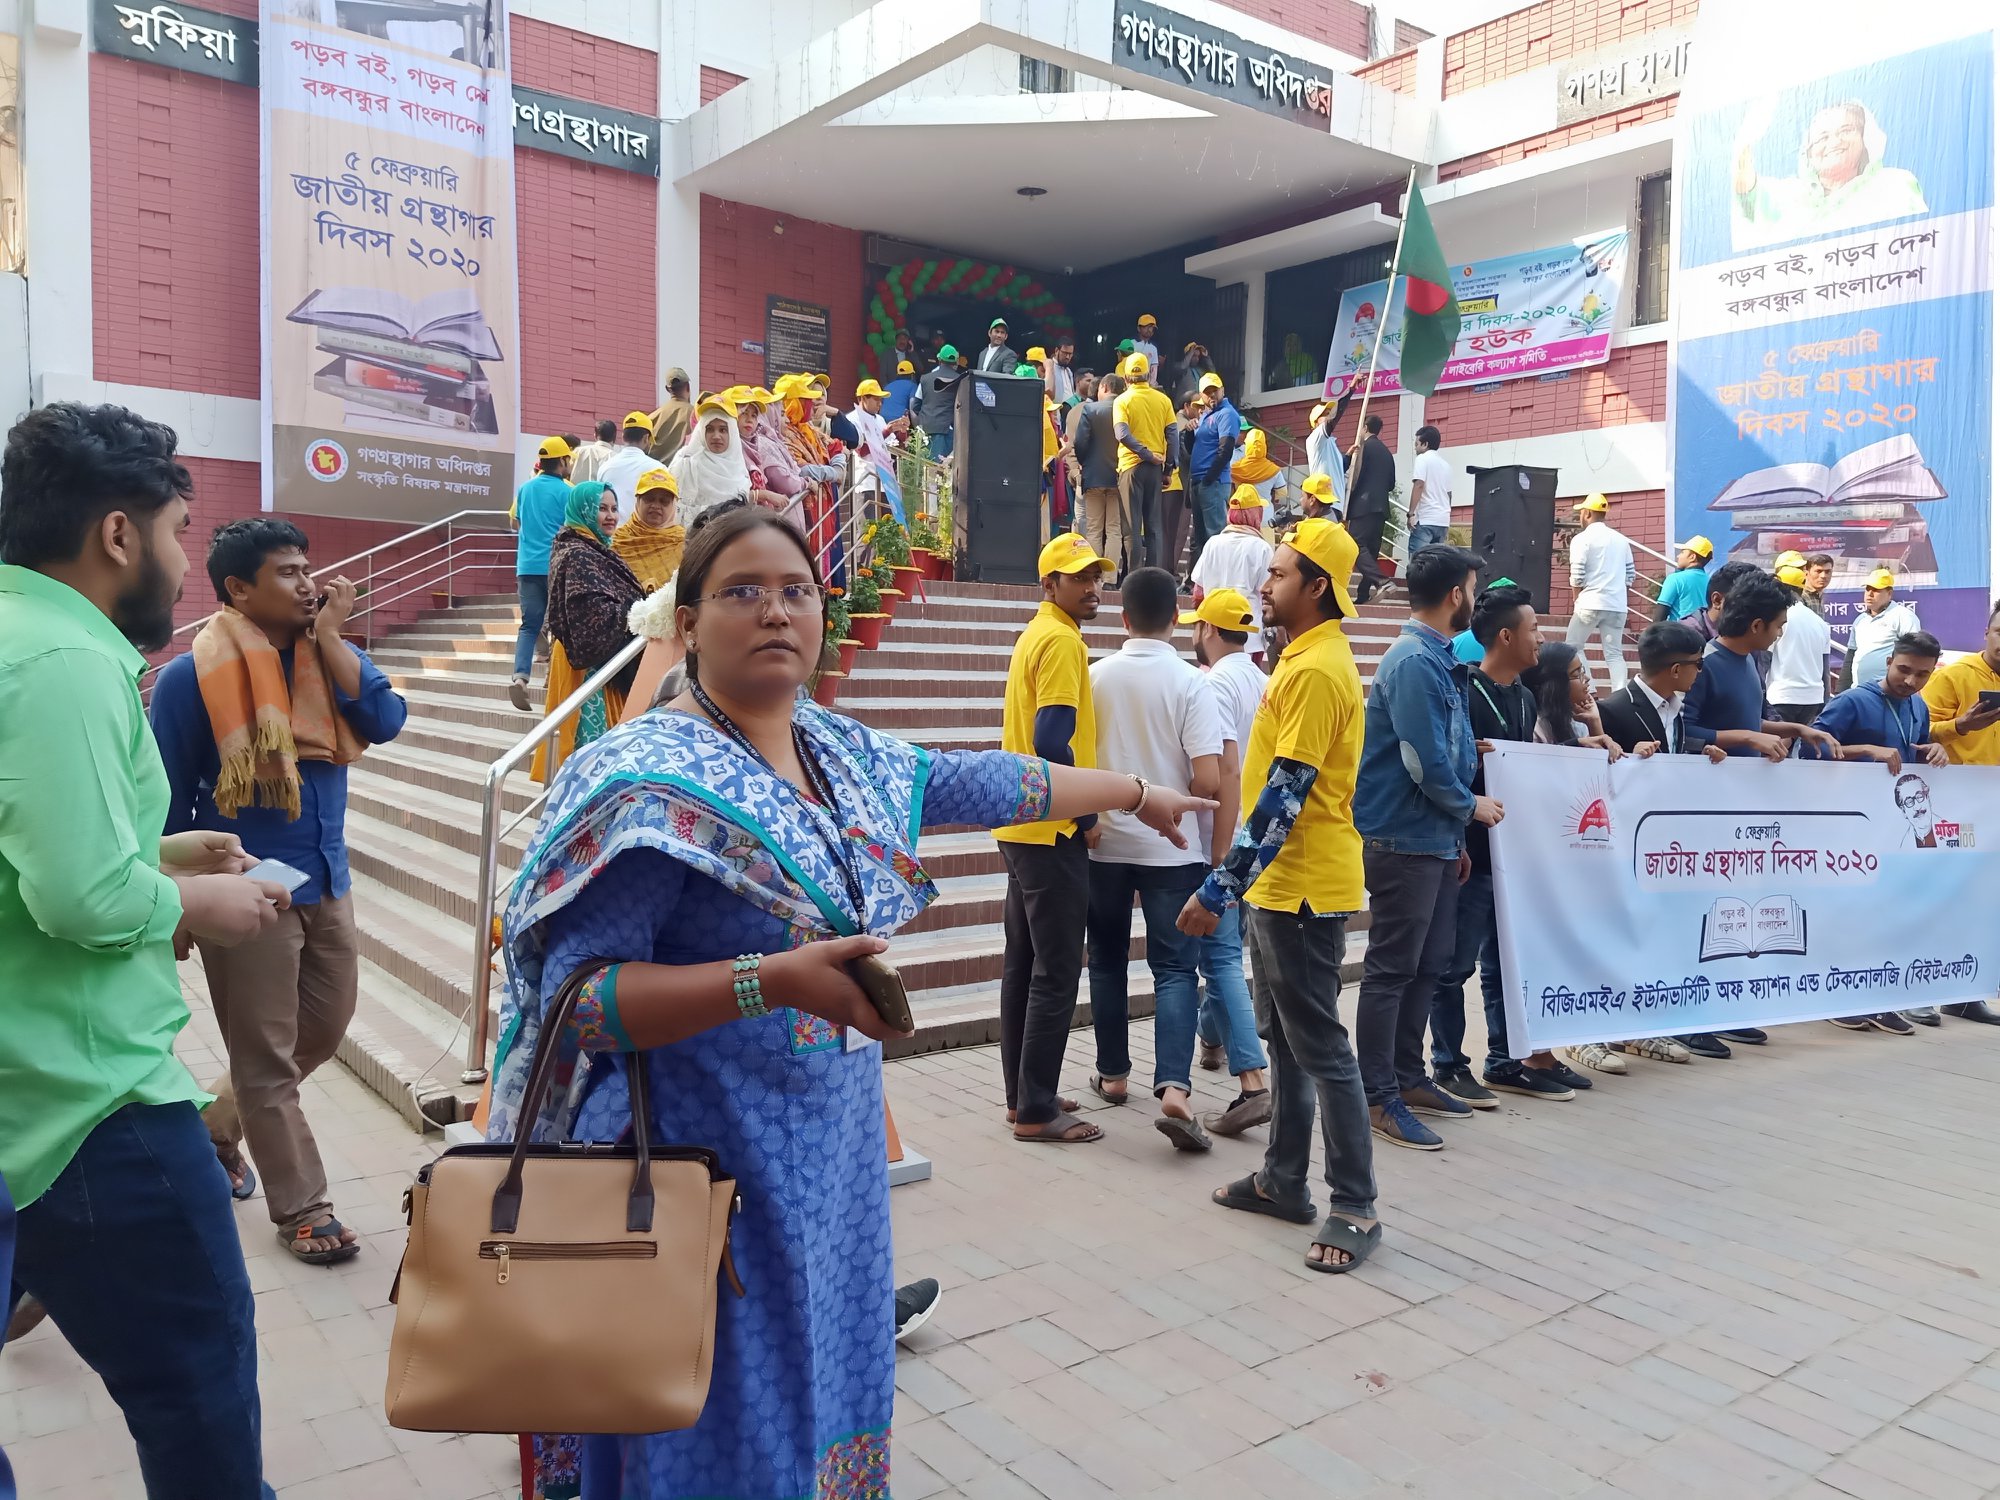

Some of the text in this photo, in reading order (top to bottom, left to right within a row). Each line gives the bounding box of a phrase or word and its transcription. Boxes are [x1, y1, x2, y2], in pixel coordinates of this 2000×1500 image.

[113, 4, 238, 64] সুফিয়া
[290, 39, 348, 67] পড়ব
[355, 52, 397, 84] বই,
[407, 67, 458, 96] গড়ব
[1120, 10, 1333, 118] গণগ্রন্থাগার অধিদপ্তর
[299, 76, 390, 116] বঙ্গবন্ধুর
[344, 151, 460, 194] ৫ ফেব্রুয়ারি
[289, 173, 496, 241] জাতীয় গ্রন্থাগার
[312, 210, 480, 278] দিবস ২০২০
[1718, 228, 1941, 288] পড়ব বই, গড়ব দেশ
[1725, 265, 1928, 317] বঙ্গবন্ধুর বাংলাদেশ
[1763, 327, 1883, 369] ৫ ফেব্রুয়ারি
[1715, 356, 1941, 407] জাতীয় গ্রন্থাগার
[1735, 401, 1918, 441] দিবস ২০২০
[356, 469, 492, 497] সংস্কৃতি বিষয়ক মন্ত্রণালয়
[357, 446, 432, 471] গণগ্রন্থাগার
[434, 454, 492, 478] অধিদপ্তর
[717, 713, 726, 722] &
[723, 719, 760, 758] Technology
[1734, 821, 1781, 841] ৫ ফেব্রুয়ারি
[1645, 840, 1878, 882] জাতীয় গ্রন্থাগার দিবস ২০২০
[1737, 906, 1746, 919] বই
[1541, 983, 1626, 1018] বিজিএমইএ
[1631, 974, 1711, 1014] ইউনিভার্সিটি
[1714, 980, 1744, 1002] অফ
[1748, 974, 1791, 1000] ফ্যাশন
[1796, 973, 1820, 995] এন্ড
[1825, 960, 1901, 993] টেকনোলজি
[1904, 953, 1979, 990] (বিইউএফটি)
